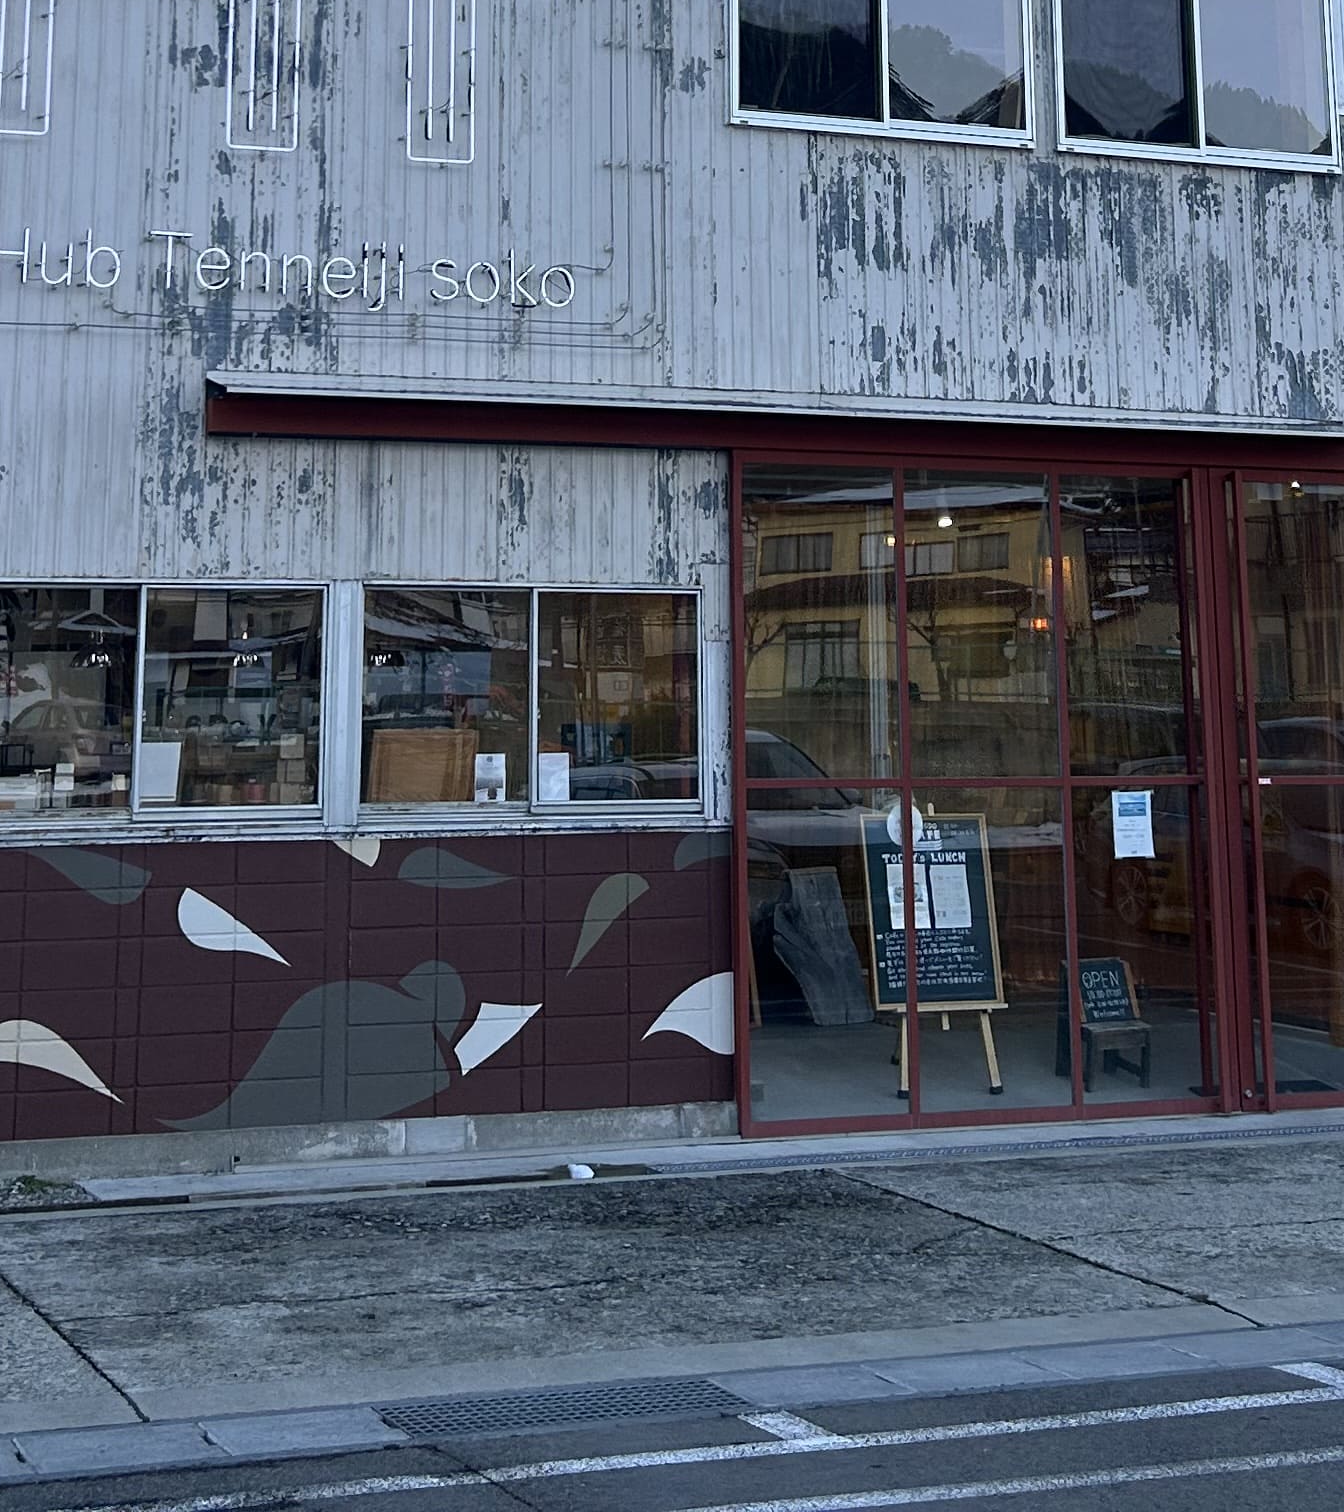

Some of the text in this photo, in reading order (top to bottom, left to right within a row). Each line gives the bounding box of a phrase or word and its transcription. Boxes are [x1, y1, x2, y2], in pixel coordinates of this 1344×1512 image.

[429, 247, 577, 310] soko
[931, 852, 966, 863] LUNCH
[1082, 970, 1120, 989] OPEN
